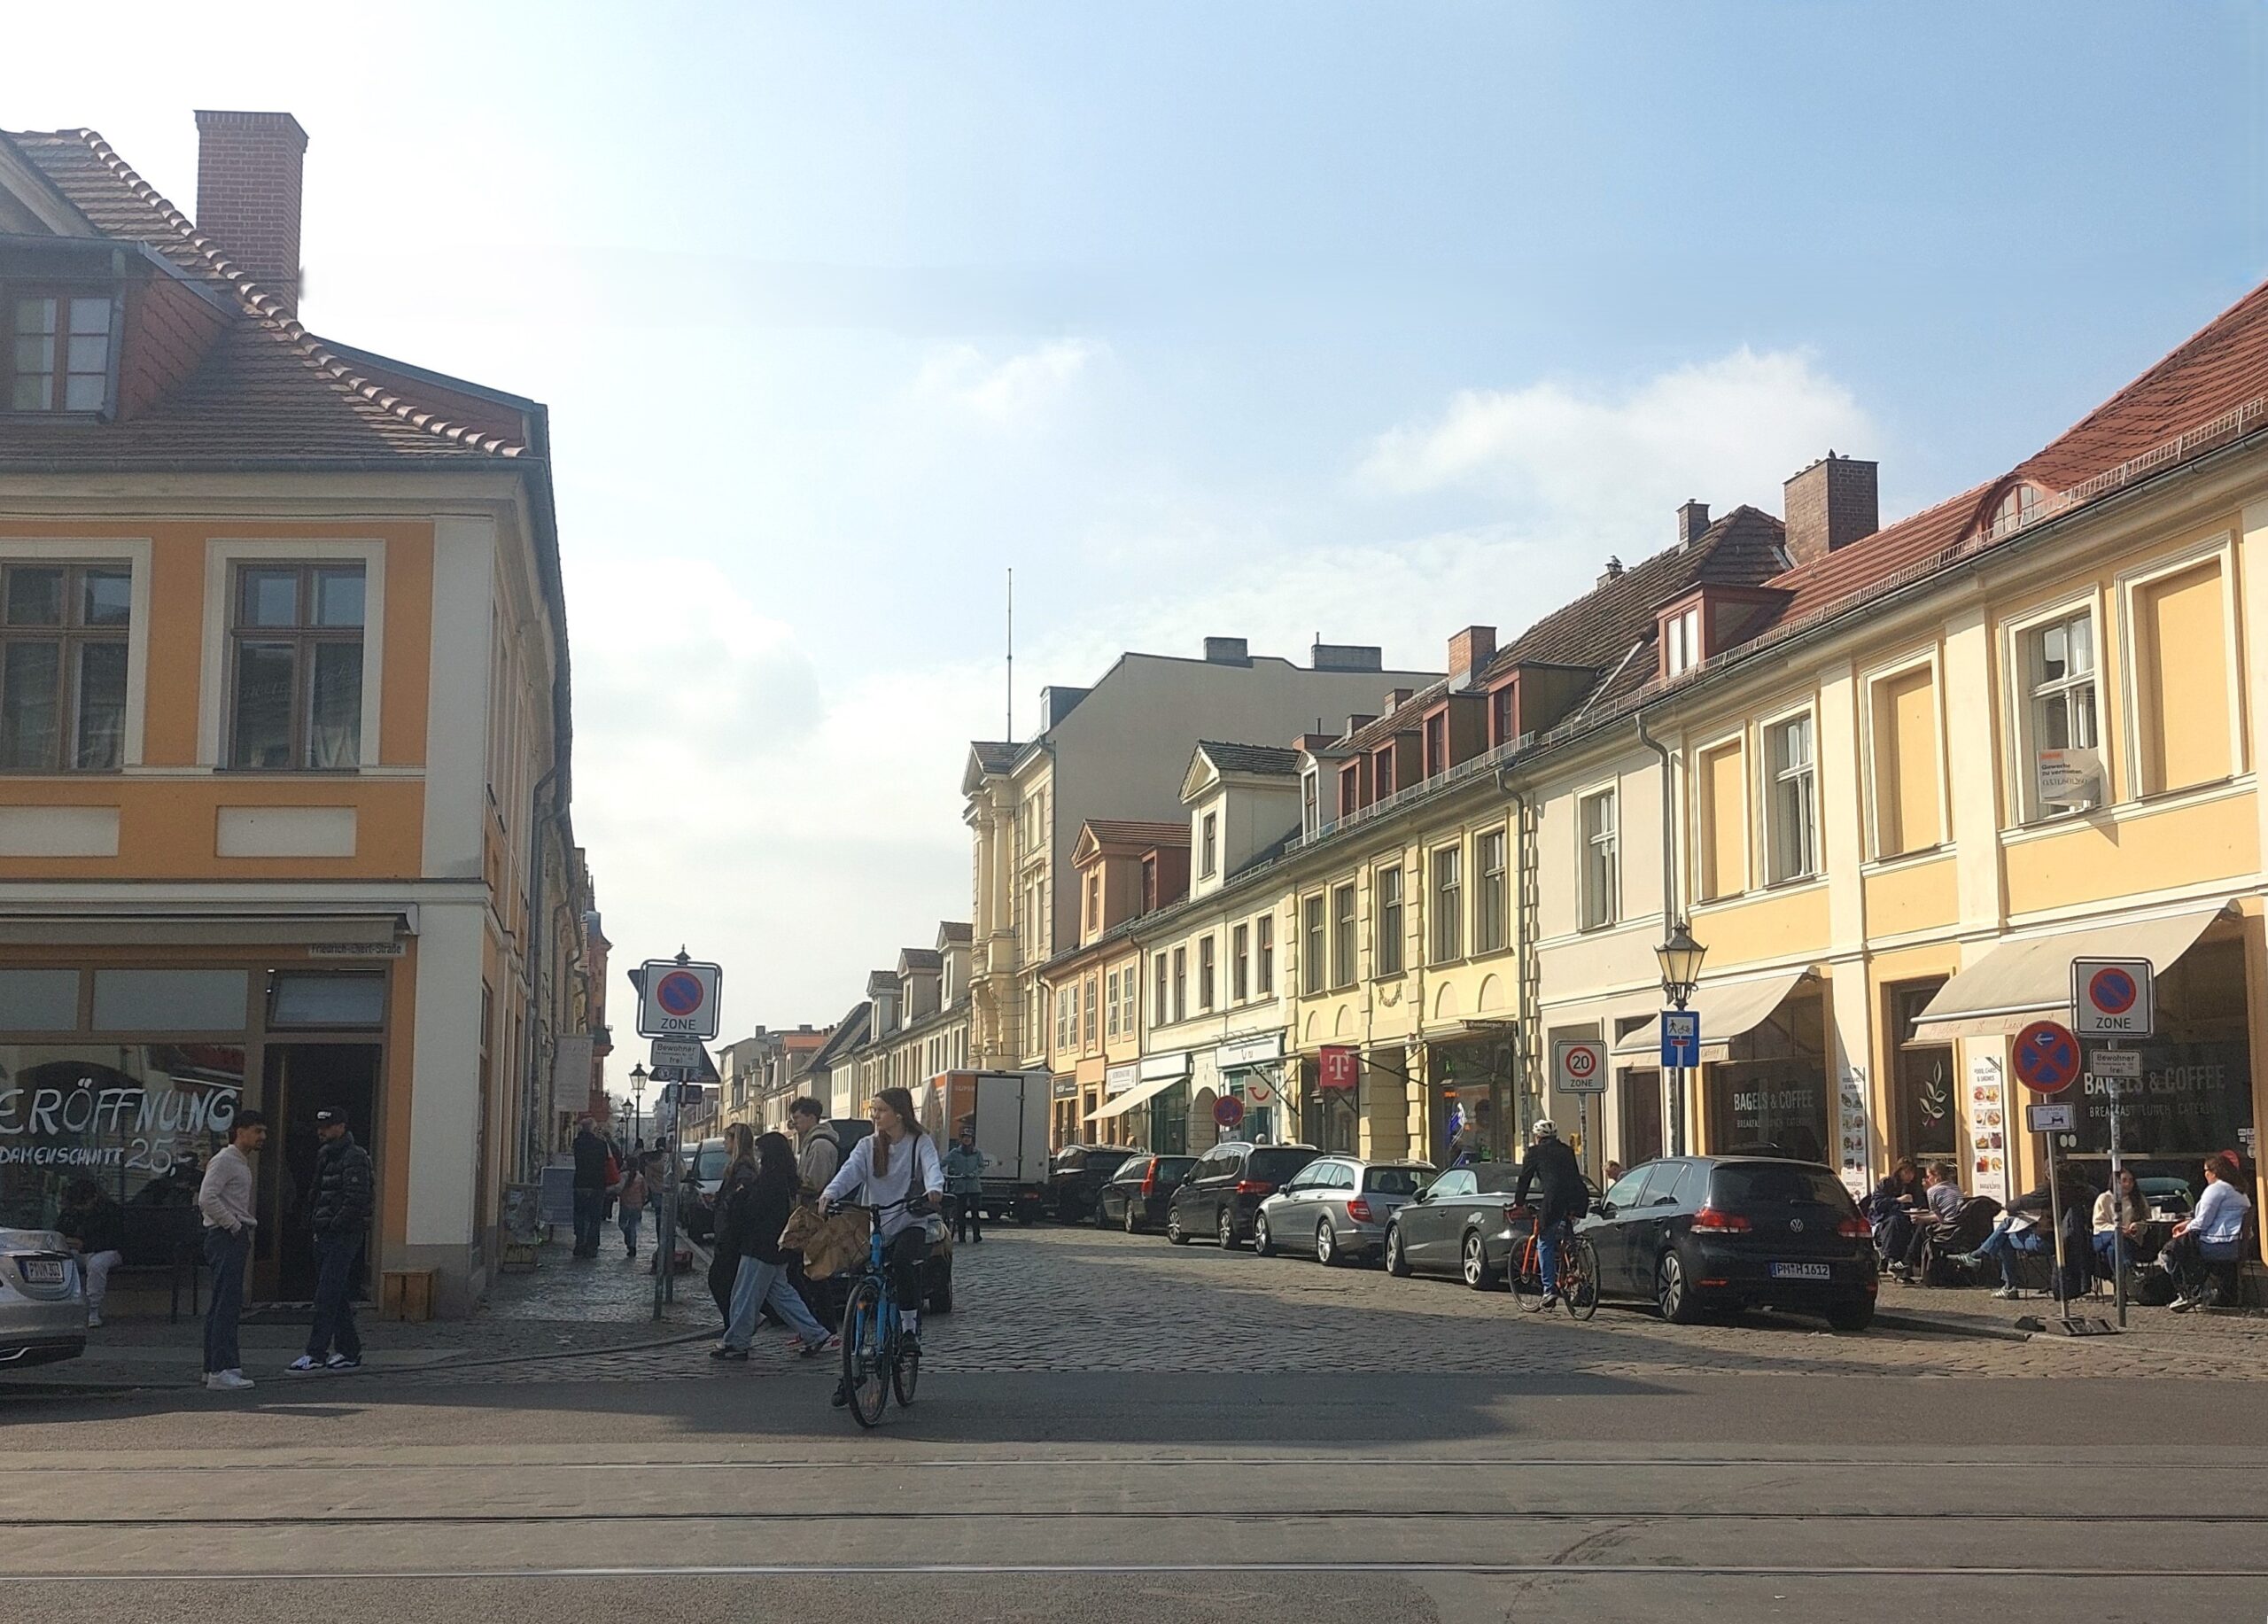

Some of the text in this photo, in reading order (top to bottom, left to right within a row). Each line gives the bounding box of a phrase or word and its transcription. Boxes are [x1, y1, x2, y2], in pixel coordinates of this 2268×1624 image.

[660, 1018, 696, 1030] ZONE
[2096, 1017, 2132, 1029] ZONE
[657, 1043, 695, 1053] Bewohner
[1329, 1055, 1349, 1080] T
[1573, 1055, 1590, 1069] 20
[1570, 1078, 1594, 1088] ZONE
[2149, 1071, 2159, 1091] &
[2164, 1065, 2226, 1092] COFFEE
[1734, 1090, 1814, 1111] BAGELS & COFFEE
[2089, 1104, 2134, 1118] BREAAST
[2141, 1104, 2171, 1117] LUNCH
[0, 1146, 124, 1165] DAMENSCHNITT
